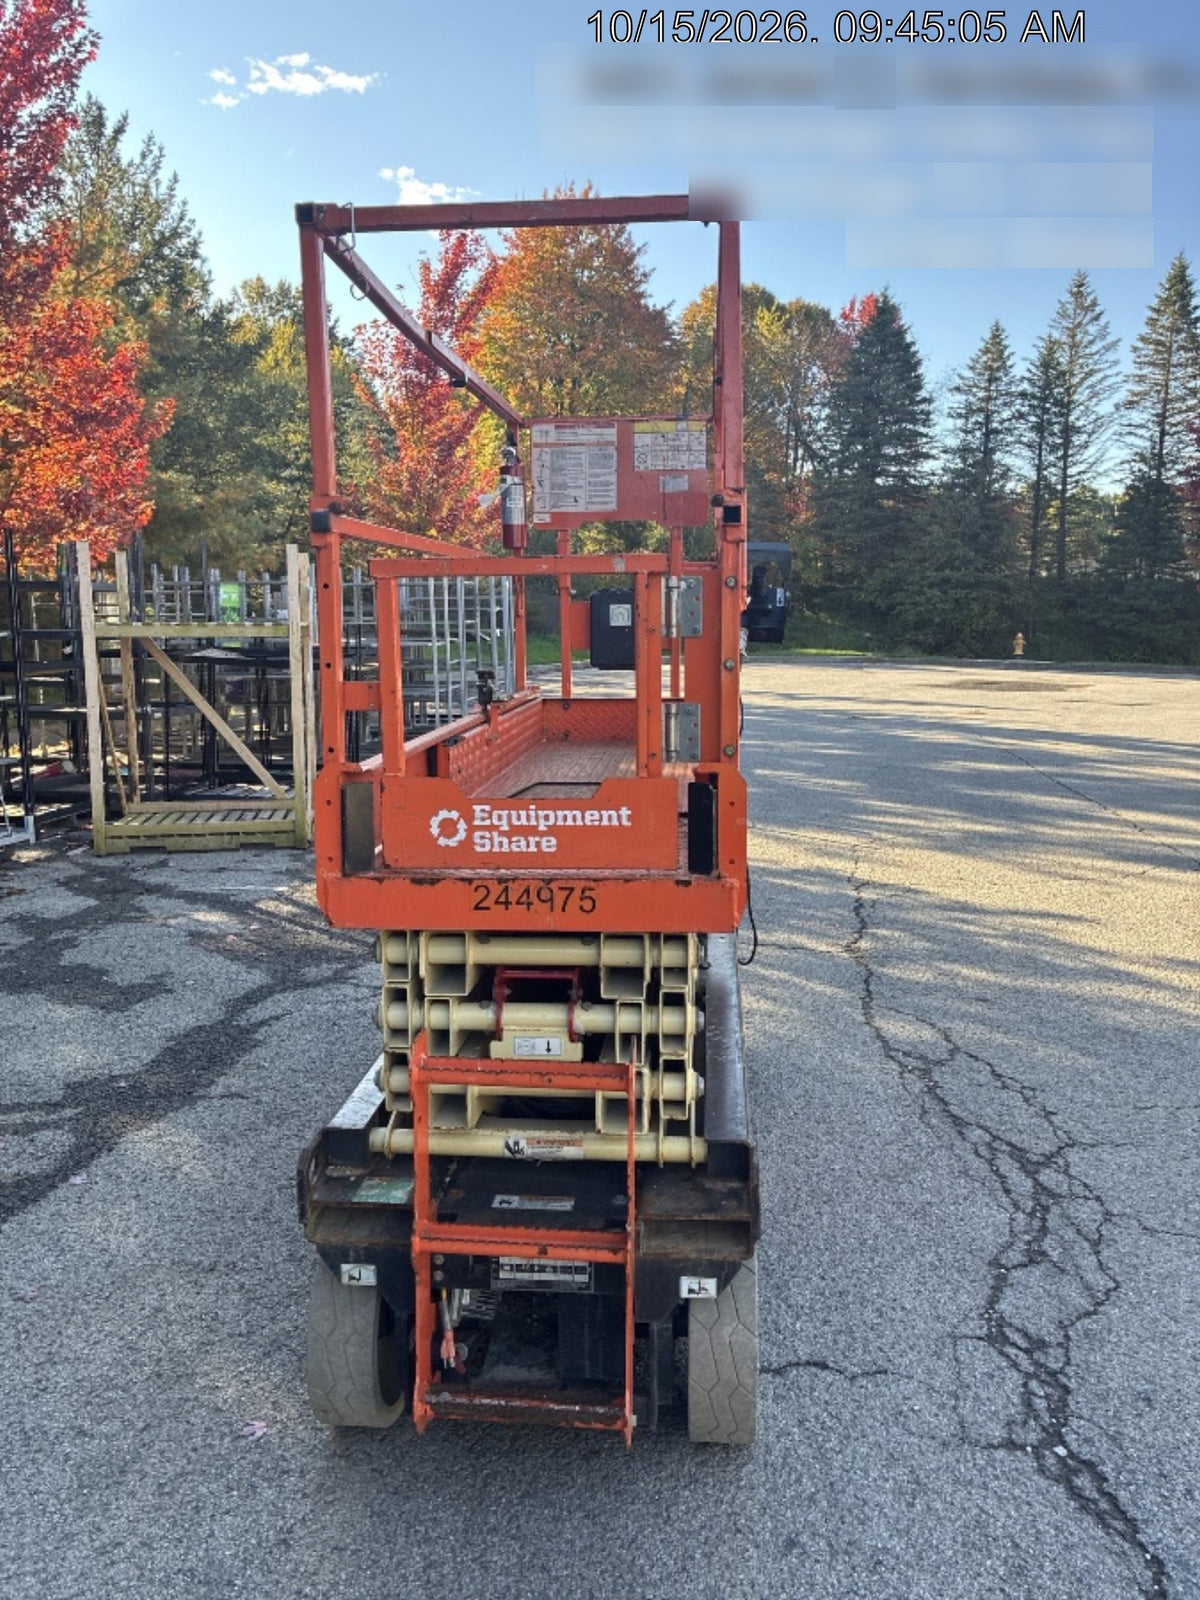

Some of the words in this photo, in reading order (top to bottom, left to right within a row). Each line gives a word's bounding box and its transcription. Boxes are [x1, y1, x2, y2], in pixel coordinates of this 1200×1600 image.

[472, 805, 632, 831] Equipment
[473, 831, 558, 852] Share
[472, 884, 597, 914] 244975
